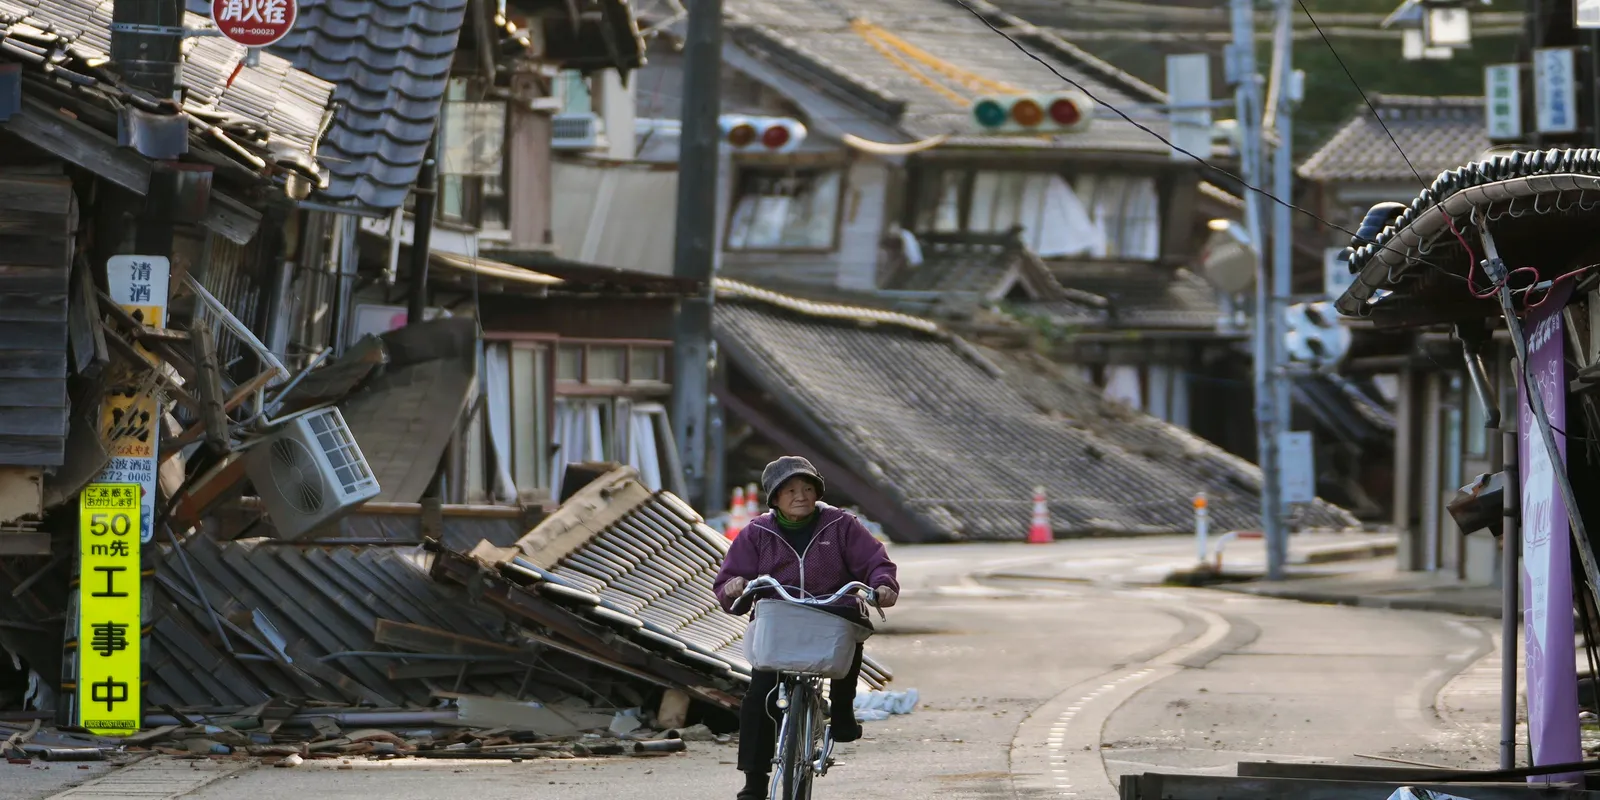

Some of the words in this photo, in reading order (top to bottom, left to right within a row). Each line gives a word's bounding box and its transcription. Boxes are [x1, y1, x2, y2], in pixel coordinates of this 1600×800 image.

[220, 0, 288, 24] 消火栓
[129, 261, 152, 302] 清酒
[87, 487, 133, 497] ご迷惑を
[87, 497, 133, 507] おかけします
[90, 513, 131, 536] 50
[91, 540, 129, 557] m先
[91, 566, 129, 712] 工事中
[85, 720, 100, 728] UNDER
[100, 720, 134, 728] CONSTRUCTION
